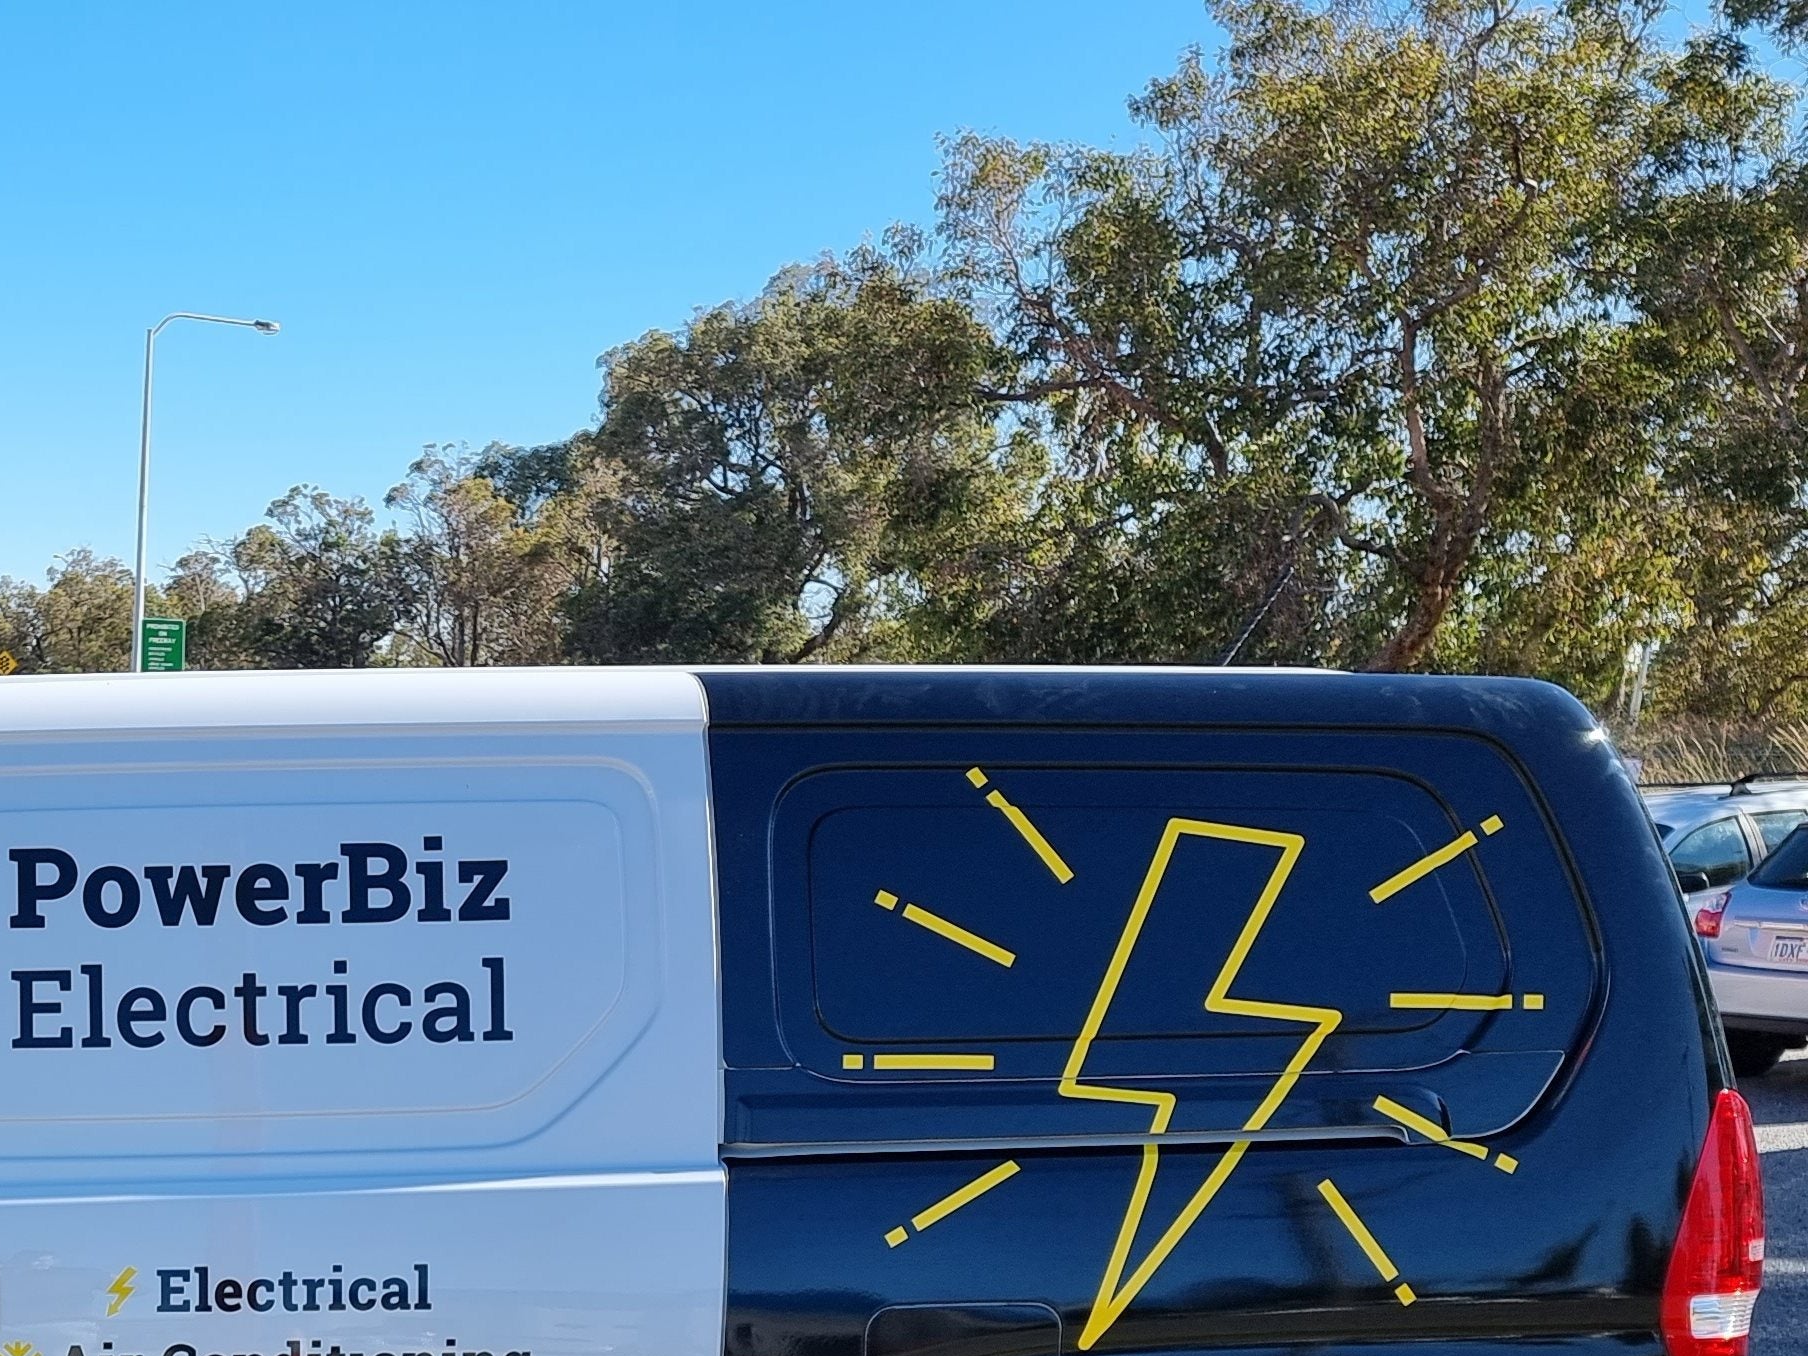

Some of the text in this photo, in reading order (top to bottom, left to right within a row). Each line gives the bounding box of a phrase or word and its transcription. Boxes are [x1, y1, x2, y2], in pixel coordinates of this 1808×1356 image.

[7, 834, 511, 930] PowerBiz
[9, 955, 515, 1050] Electrical
[155, 1263, 433, 1314] Electrical
